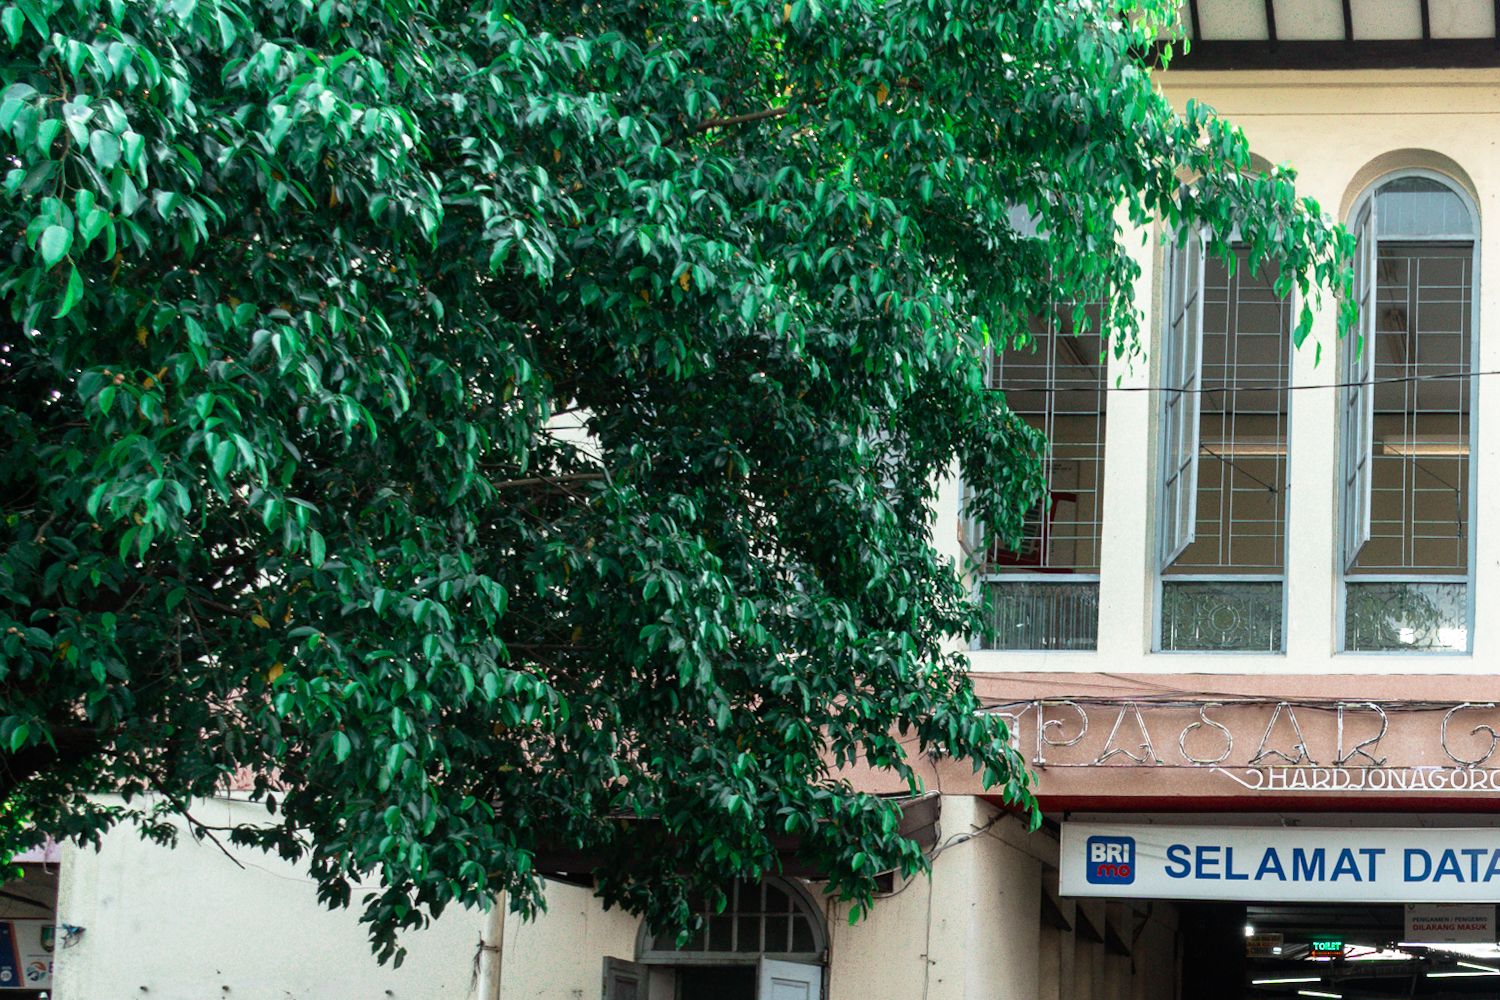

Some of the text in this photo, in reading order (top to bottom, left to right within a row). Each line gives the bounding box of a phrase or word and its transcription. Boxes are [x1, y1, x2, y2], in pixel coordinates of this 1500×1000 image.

[1031, 701, 1388, 766] PASAR
[1091, 842, 1130, 864] BRI
[1096, 864, 1131, 878] mo
[1164, 843, 1387, 883] SELAMAT
[1456, 923, 1488, 932] MASUK
[1312, 941, 1342, 951] TOILET
